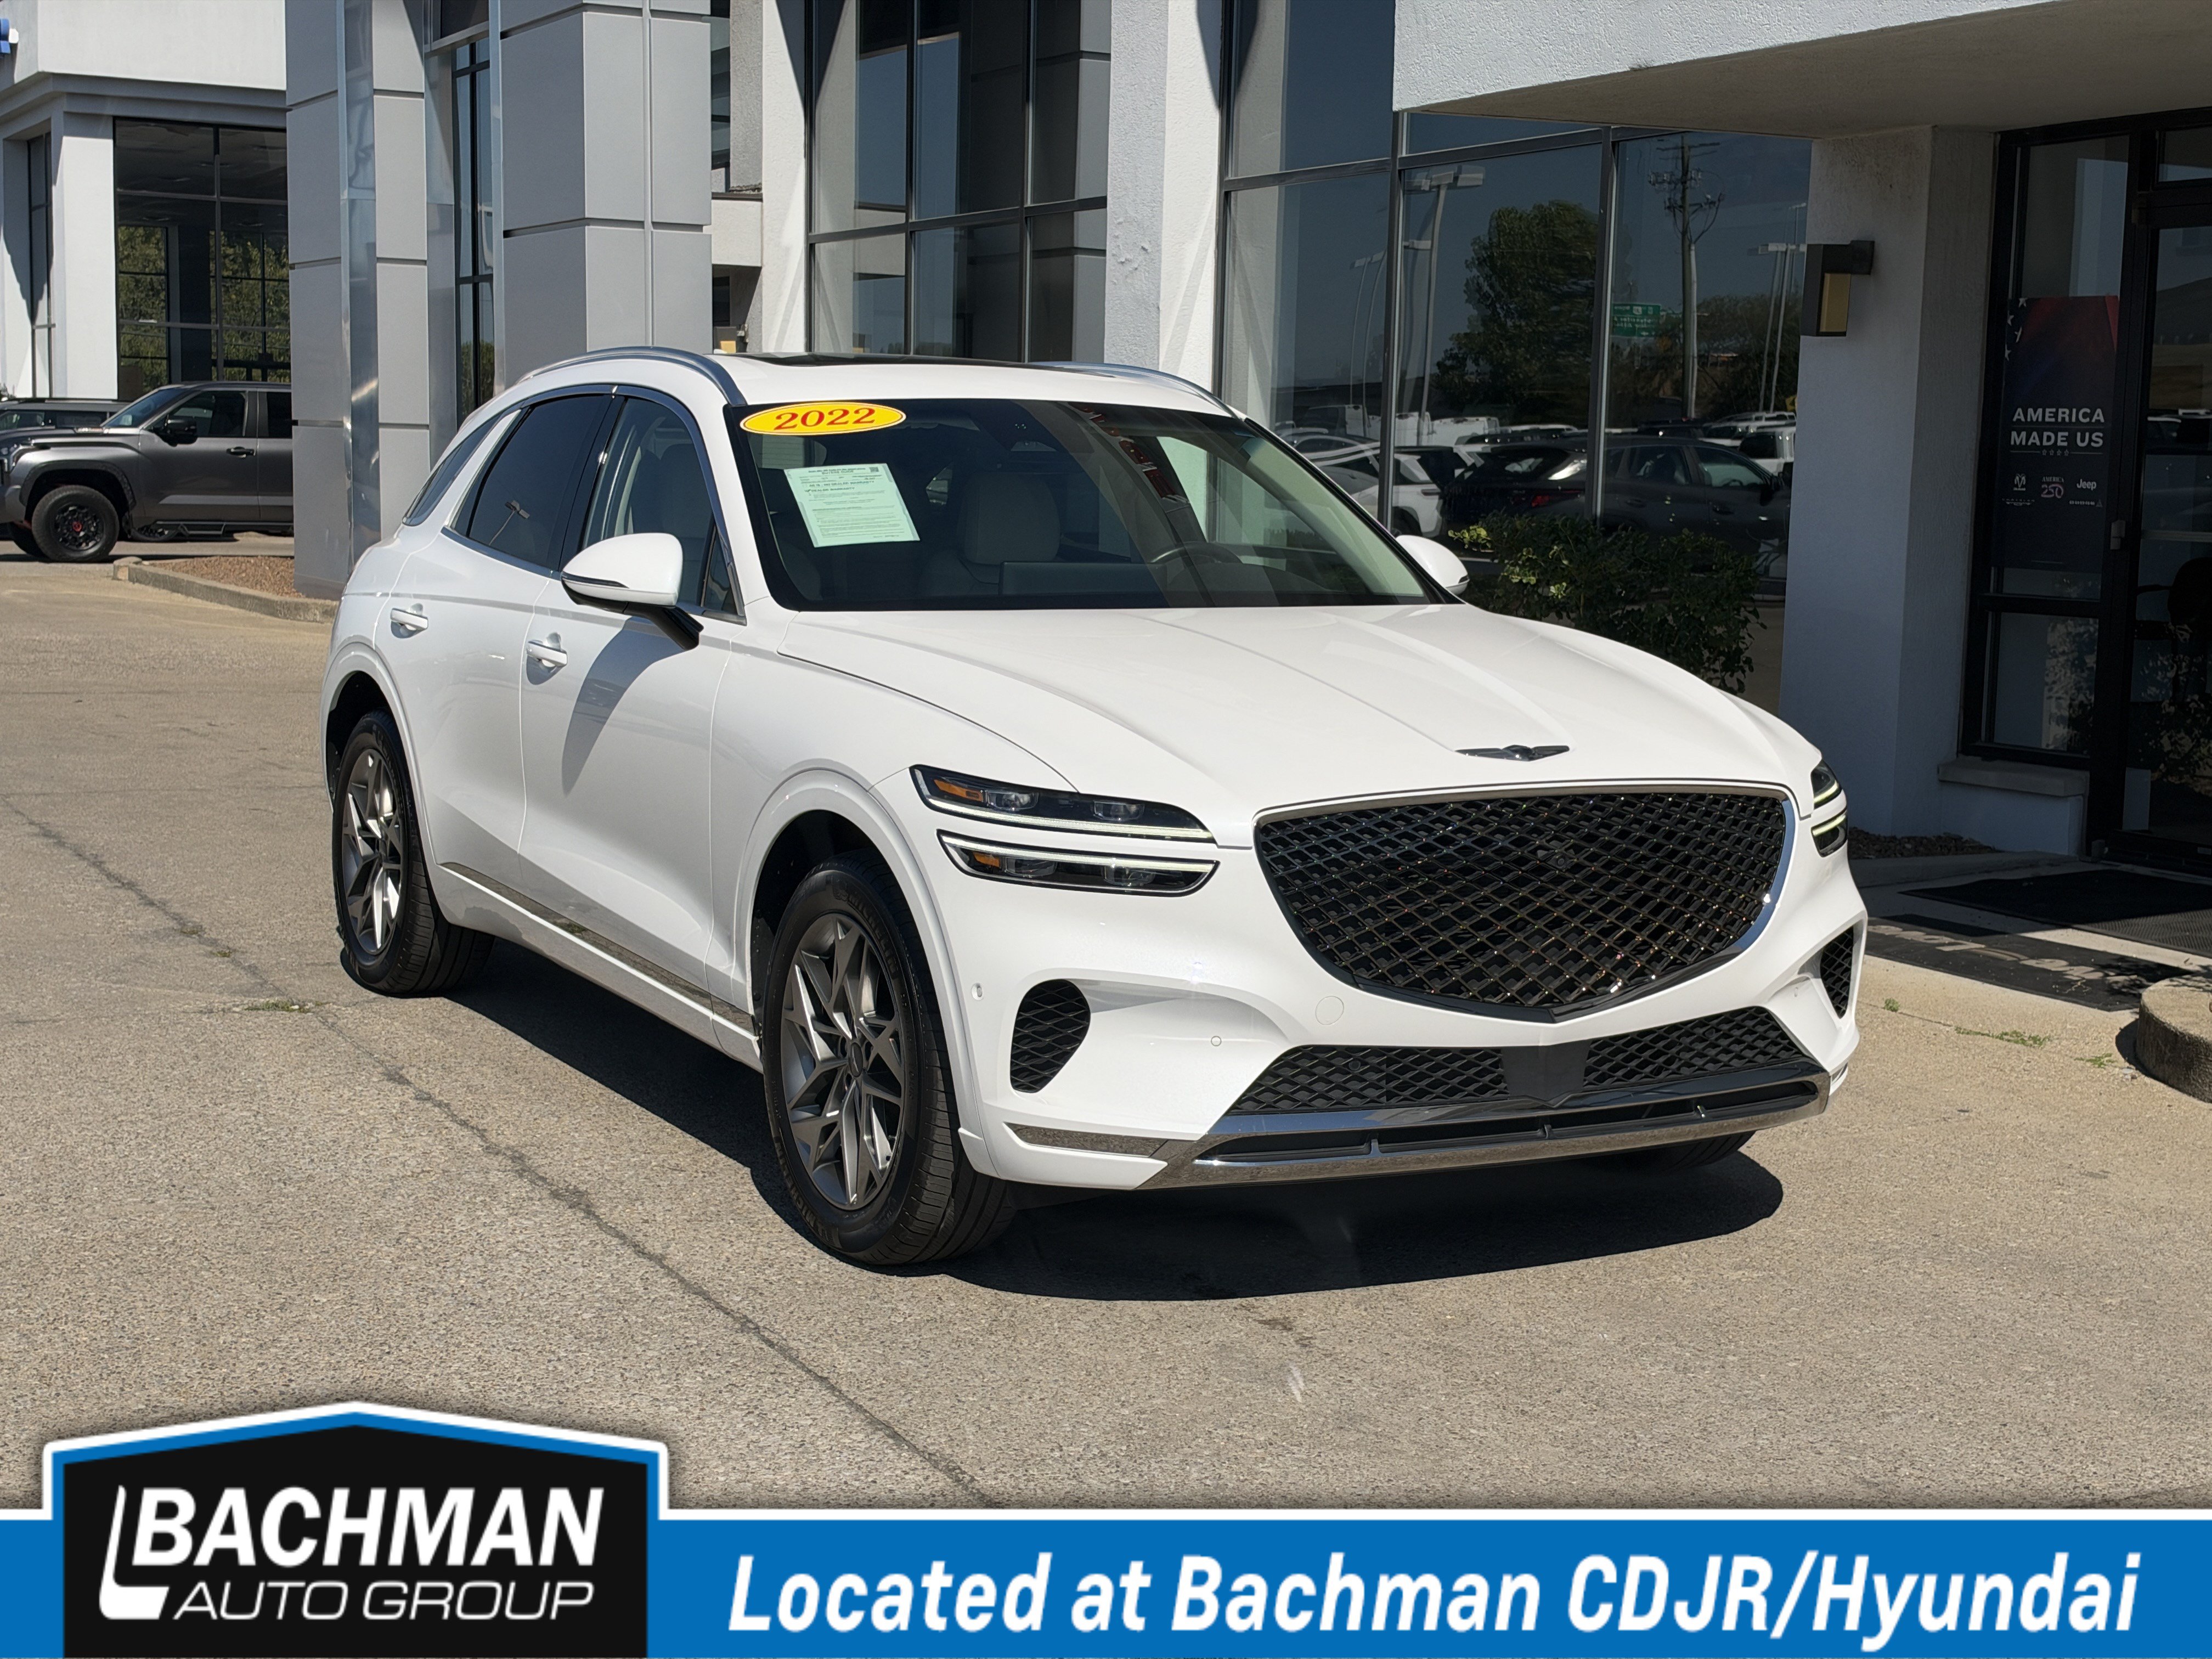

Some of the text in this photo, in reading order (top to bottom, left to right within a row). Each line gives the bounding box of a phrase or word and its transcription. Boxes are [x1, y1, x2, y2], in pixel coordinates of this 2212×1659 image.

[773, 408, 876, 430] 2022
[2012, 408, 2104, 423] AMERICA
[2010, 431, 2104, 448] MADE US
[2041, 483, 2064, 499] 250
[2076, 478, 2097, 491] Jeep
[848, 894, 899, 973] MICHELIN
